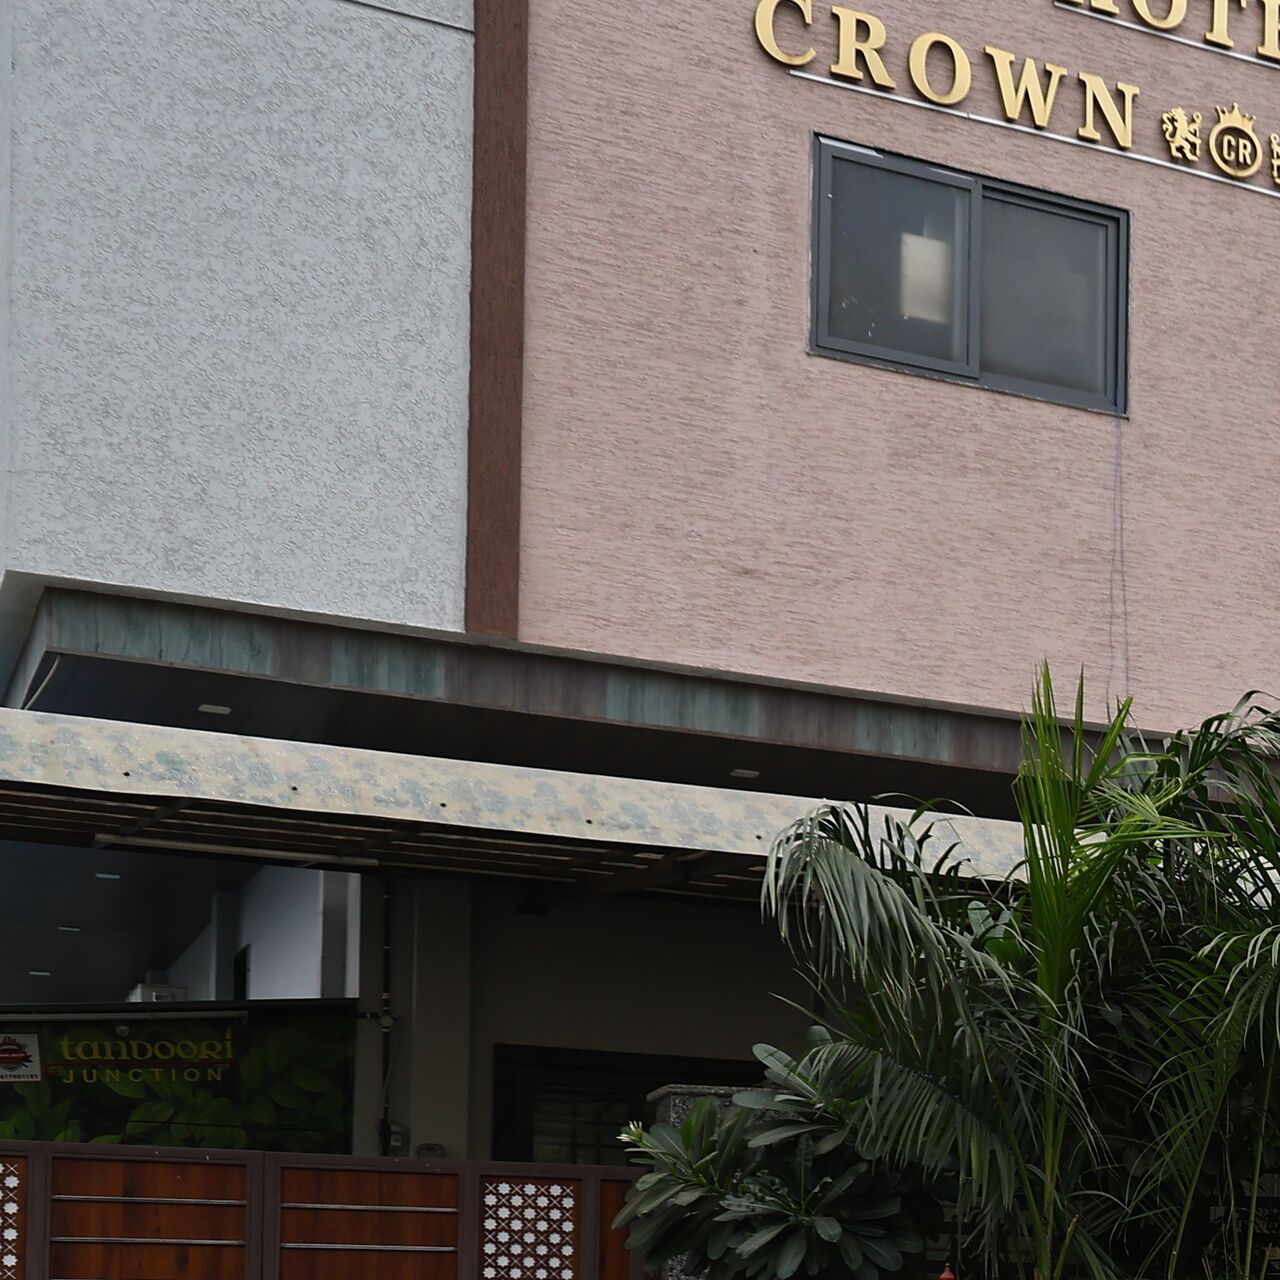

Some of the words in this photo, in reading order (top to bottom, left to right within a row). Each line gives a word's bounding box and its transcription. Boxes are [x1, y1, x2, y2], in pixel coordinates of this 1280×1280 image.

[755, 0, 1139, 149] CROWN
[1222, 134, 1252, 166] CR
[62, 1068, 223, 1084] JUNCTION
